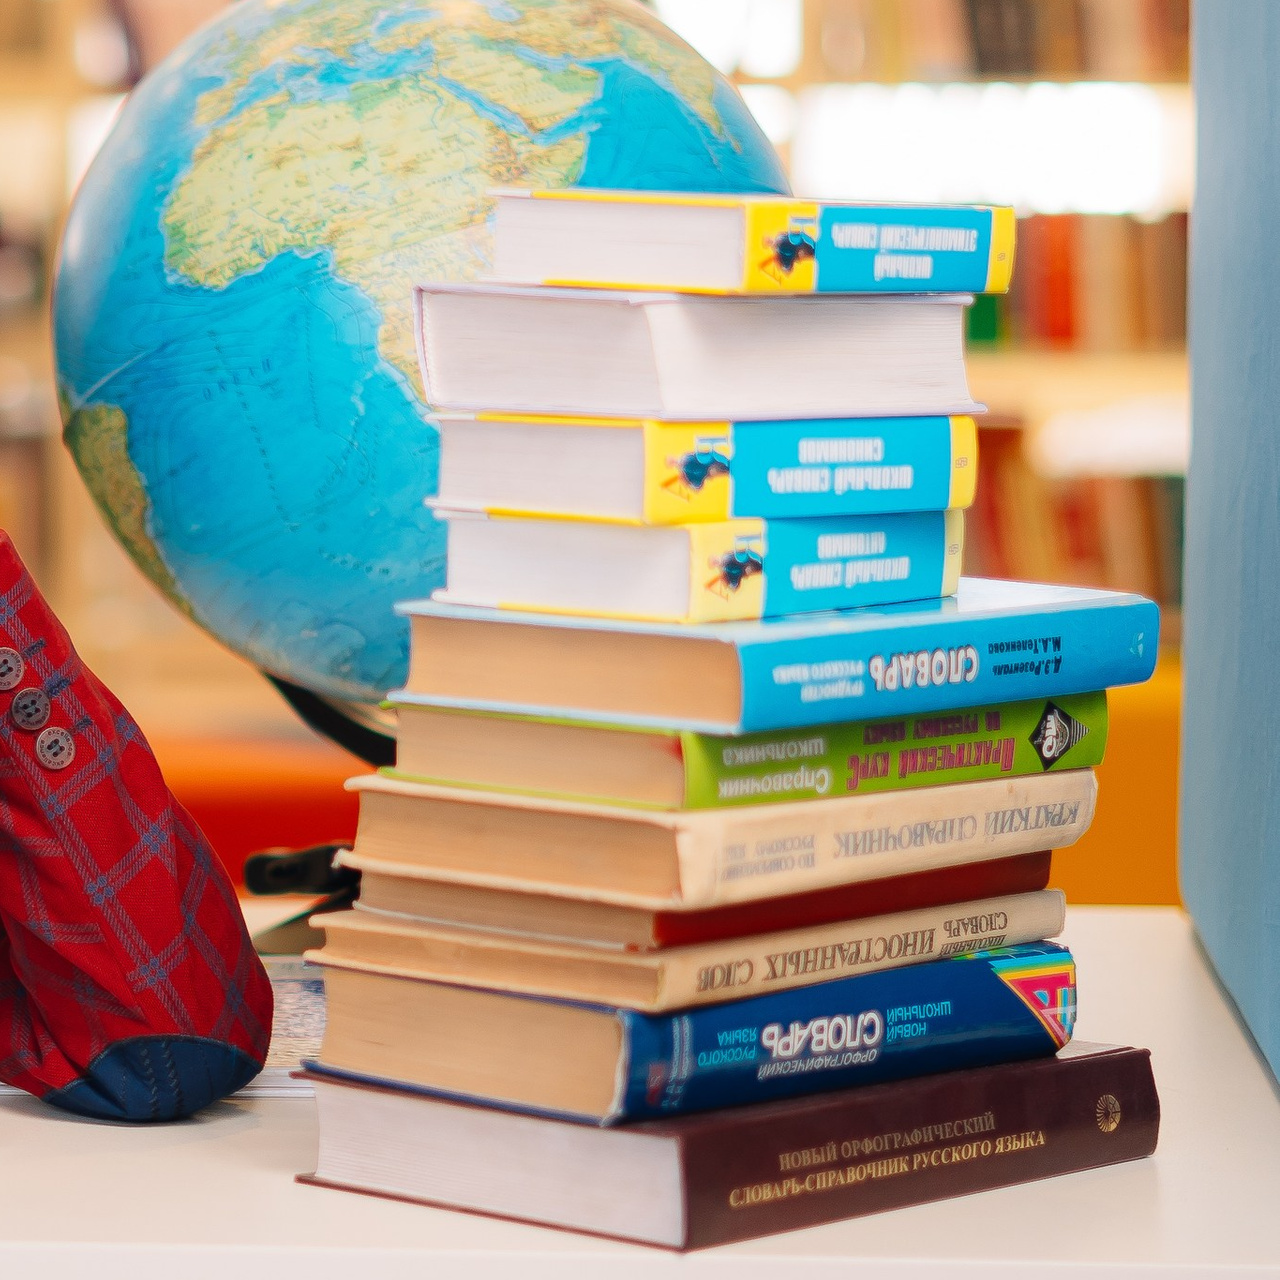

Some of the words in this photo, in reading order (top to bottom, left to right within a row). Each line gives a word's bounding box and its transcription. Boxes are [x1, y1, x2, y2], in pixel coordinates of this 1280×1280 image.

[867, 643, 978, 691] СЛОВАРЬ
[721, 736, 824, 764] школьника
[717, 765, 830, 796] Справочник
[983, 800, 1079, 840] КРАТКИЙ
[831, 814, 976, 858] СПРАВОЧНИК
[942, 910, 1006, 937] СЛОВАРЬ
[761, 926, 936, 981] ИНОСТРАННЫХ
[936, 933, 1006, 956] ШКОЛЬНЫЙ
[694, 958, 753, 992] СЛОВ
[885, 1000, 950, 1020] ШКОЛЬНЫЙ
[716, 1026, 756, 1045] ЯЗЫКА
[760, 1010, 880, 1058] СЛОВАРЬ
[886, 1021, 926, 1041] НОВЫЙ
[696, 1045, 755, 1066] РУССКОГО
[756, 1048, 876, 1079] ОРФОГРАФИЧЕСКИЙ
[779, 1142, 838, 1170] НОВЫЙ
[840, 1111, 996, 1158] ОРФОГРАФИЧЕСКИЙ
[729, 1154, 909, 1208] СЛОВАРЬ-СПРАВОЧНИК
[912, 1142, 992, 1170] РУССКОГО
[995, 1130, 1046, 1154] ЯЗЫКА
